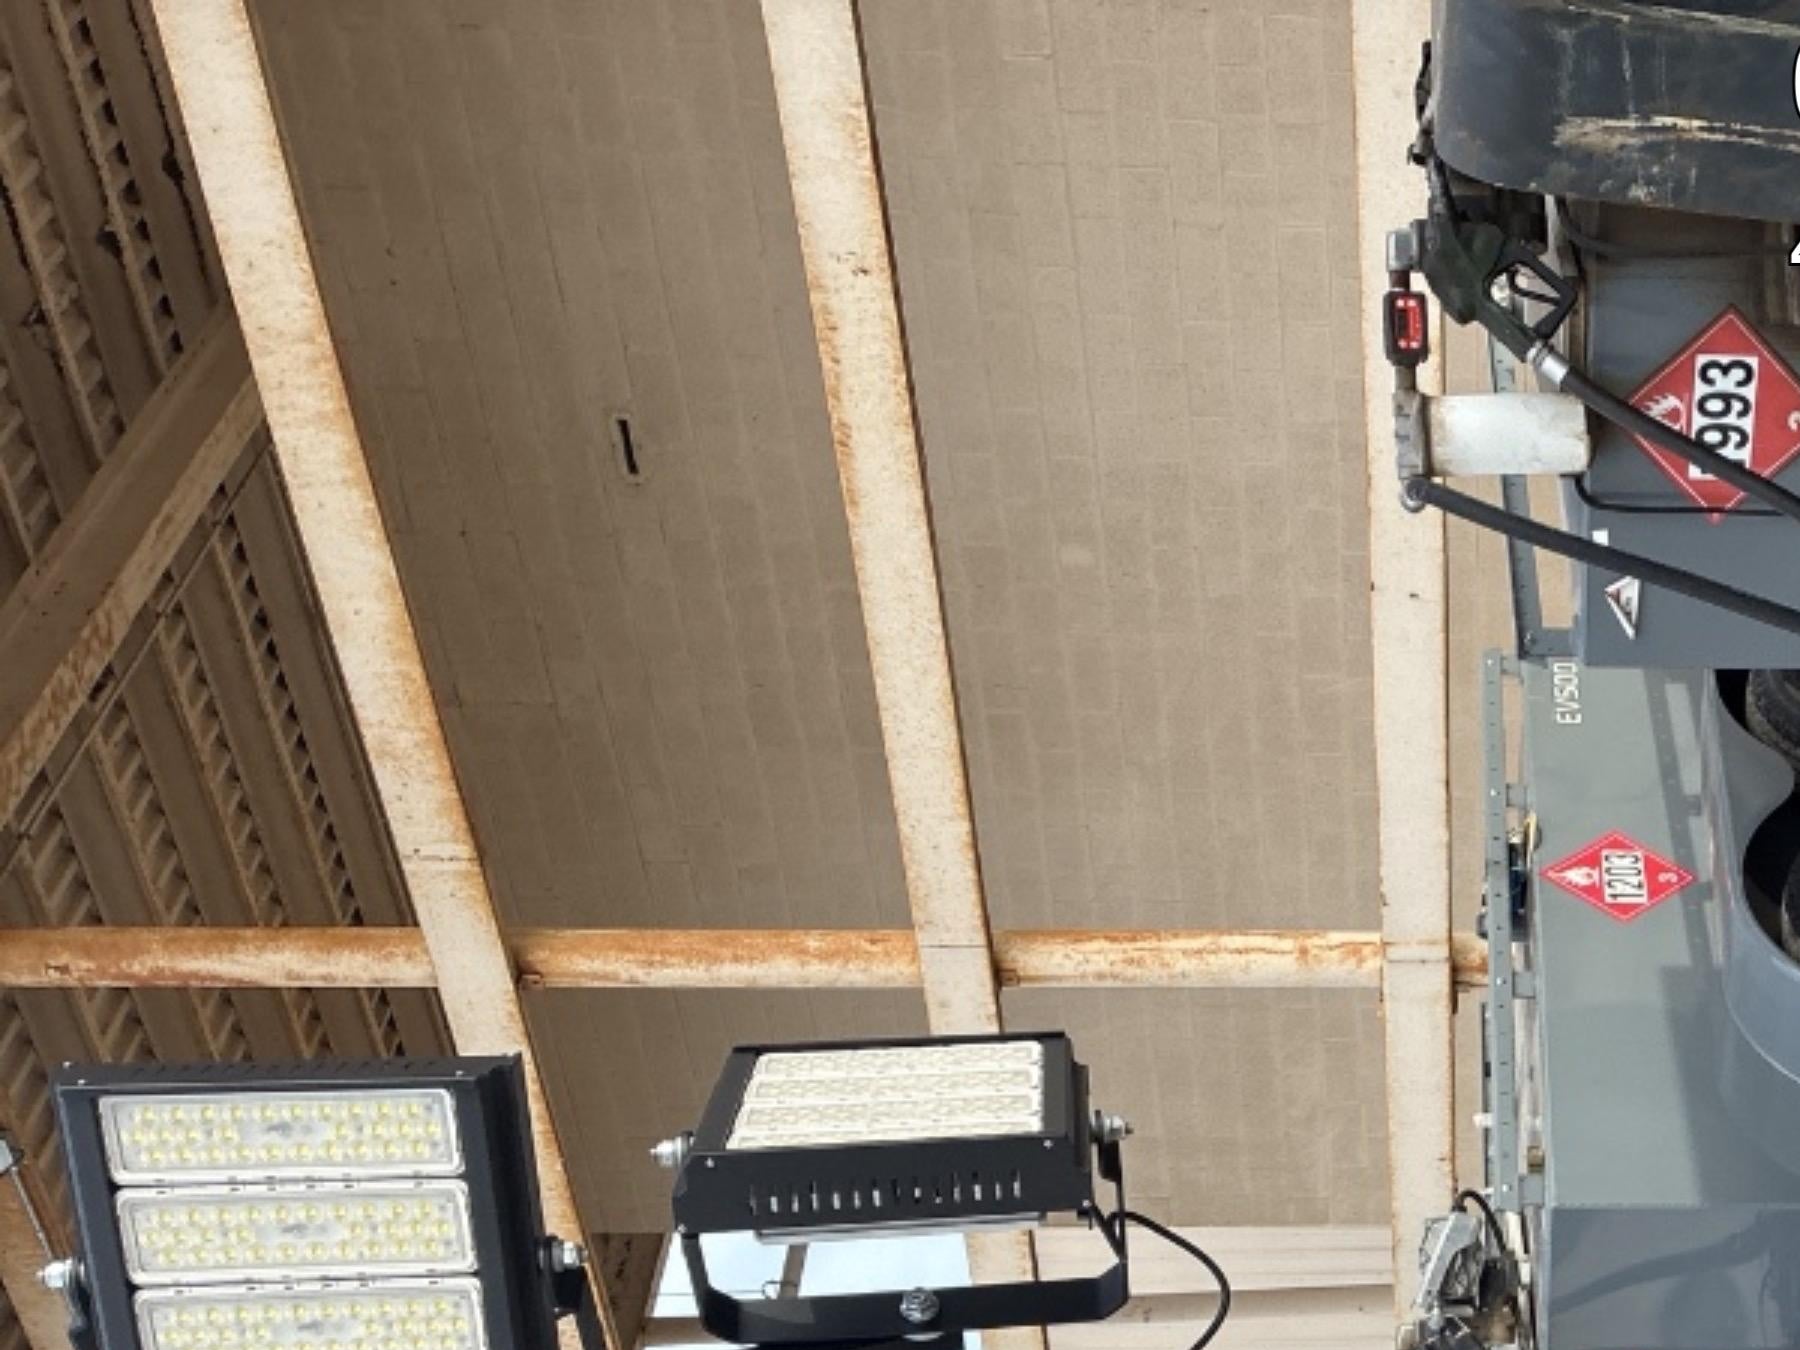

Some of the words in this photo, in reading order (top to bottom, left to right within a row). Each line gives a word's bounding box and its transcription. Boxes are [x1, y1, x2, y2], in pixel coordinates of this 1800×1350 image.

[1694, 359, 1754, 476] 993
[1553, 662, 1582, 724] EV500
[1604, 854, 1644, 901] 1203
[1657, 871, 1678, 885] 3
